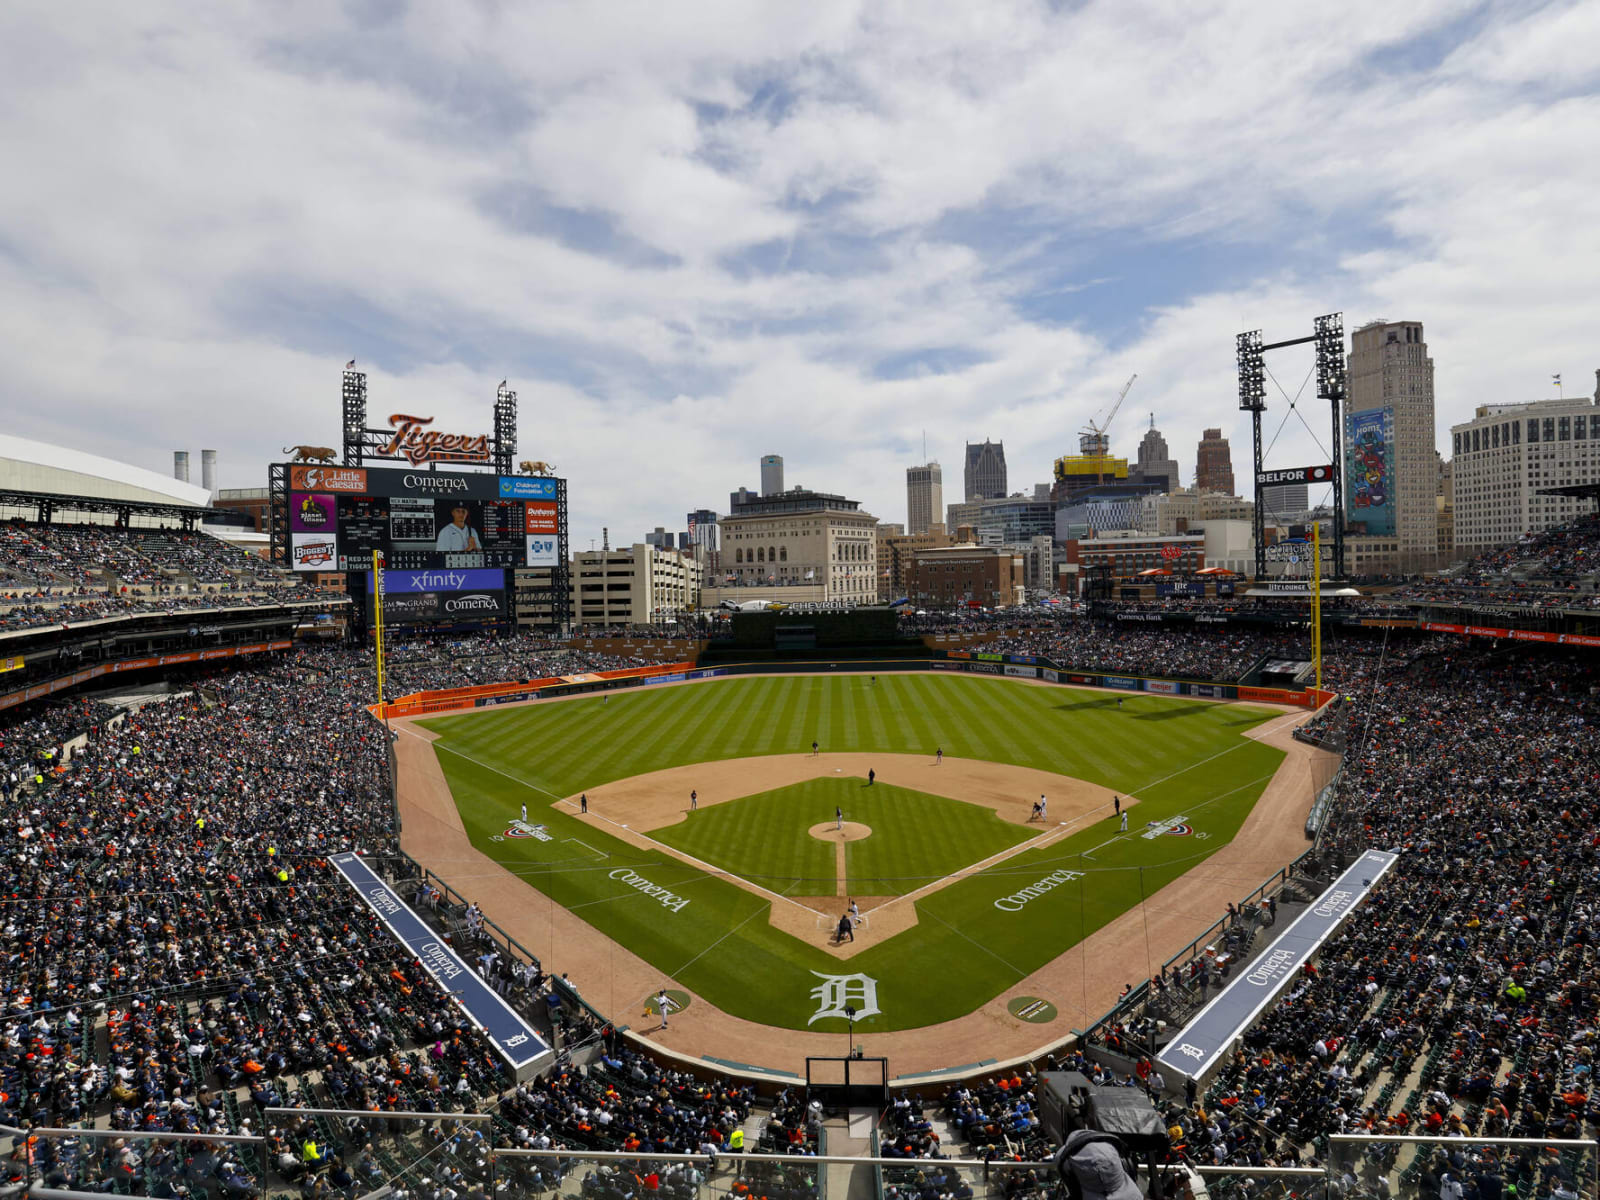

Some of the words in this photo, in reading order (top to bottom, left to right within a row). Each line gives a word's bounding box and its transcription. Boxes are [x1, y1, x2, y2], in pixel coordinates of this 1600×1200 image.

[376, 414, 491, 464] Tigers
[333, 470, 360, 481] Little
[1257, 470, 1305, 483] BELFOR
[325, 479, 364, 490] Caesars
[296, 544, 334, 558] BIGGEST
[377, 551, 386, 600] ROCKET
[411, 571, 466, 591] xfinity
[792, 600, 858, 610] CHEVROLET
